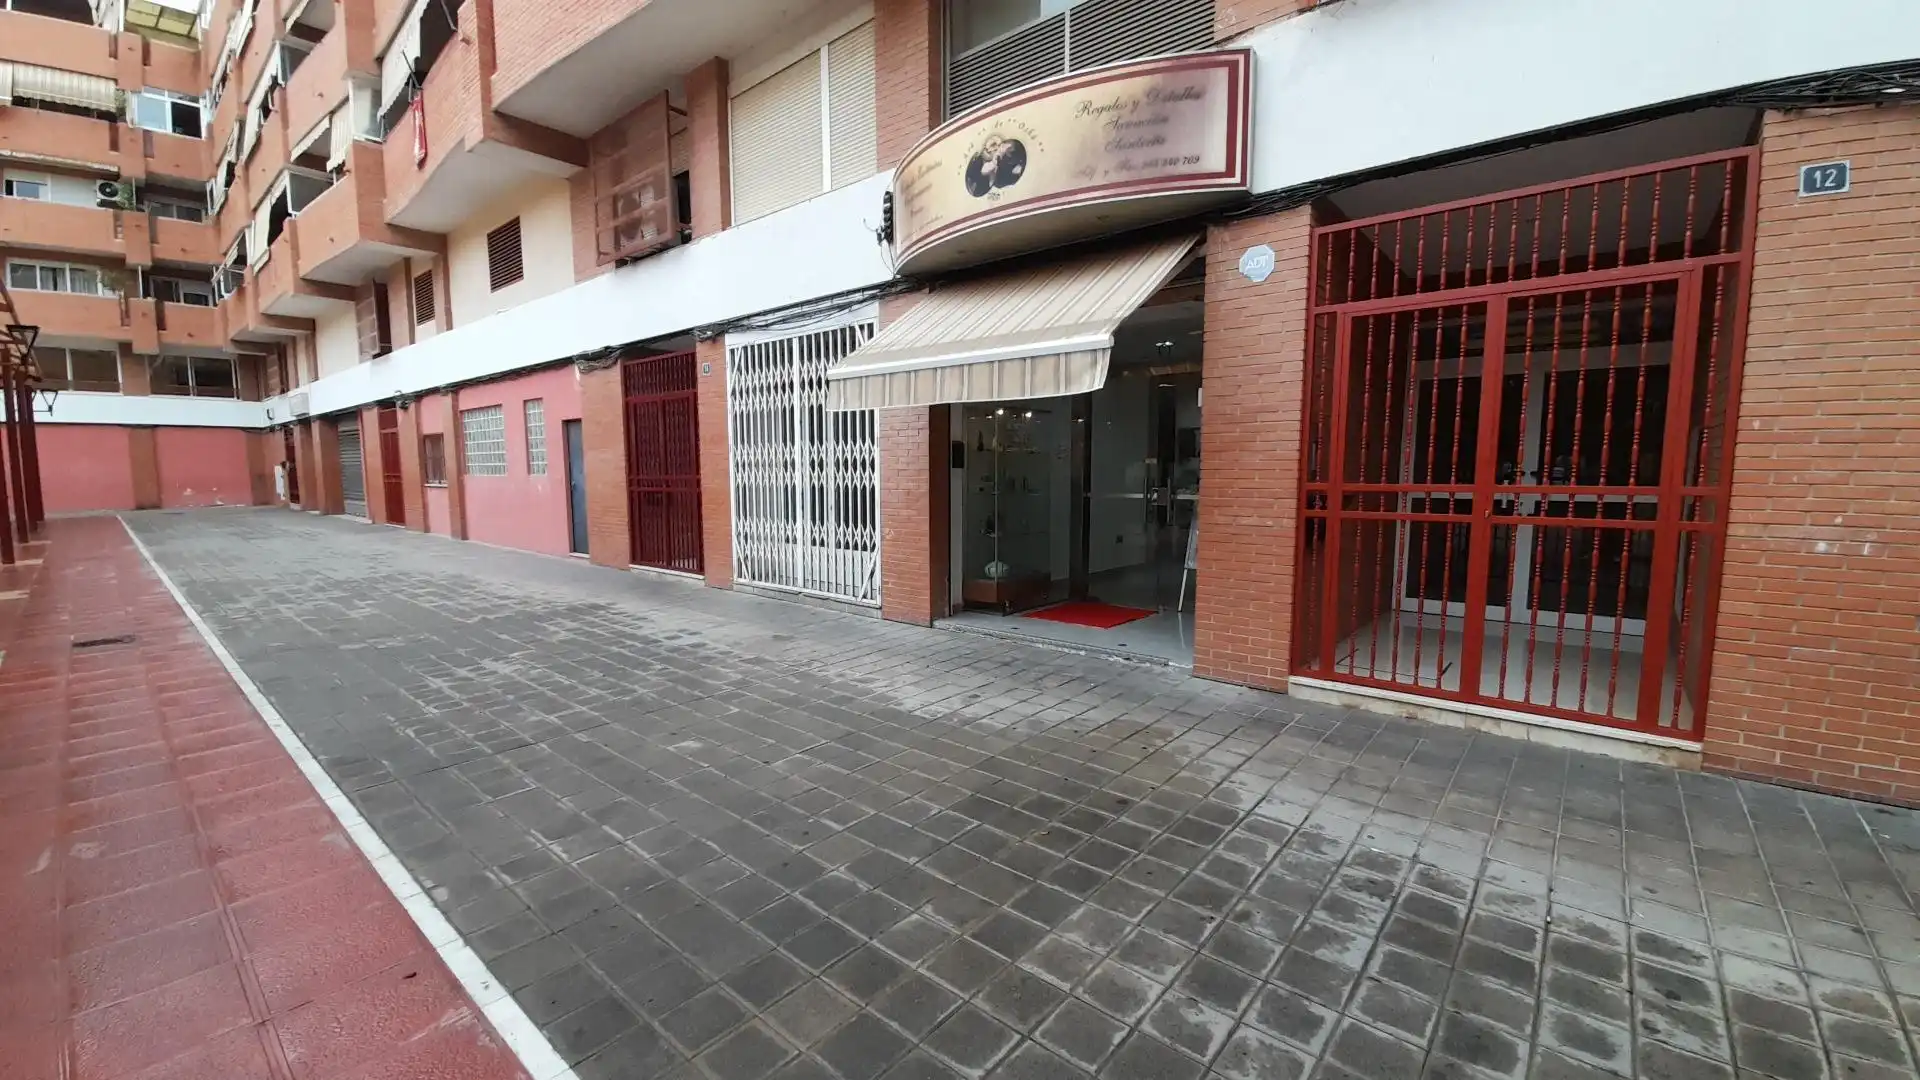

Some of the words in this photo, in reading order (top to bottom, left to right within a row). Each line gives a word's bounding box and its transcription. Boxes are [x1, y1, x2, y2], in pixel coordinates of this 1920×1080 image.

[1074, 96, 1127, 119] Regalos
[1129, 99, 1140, 114] y
[1813, 168, 1838, 189] 12
[1247, 254, 1269, 268] ADT
